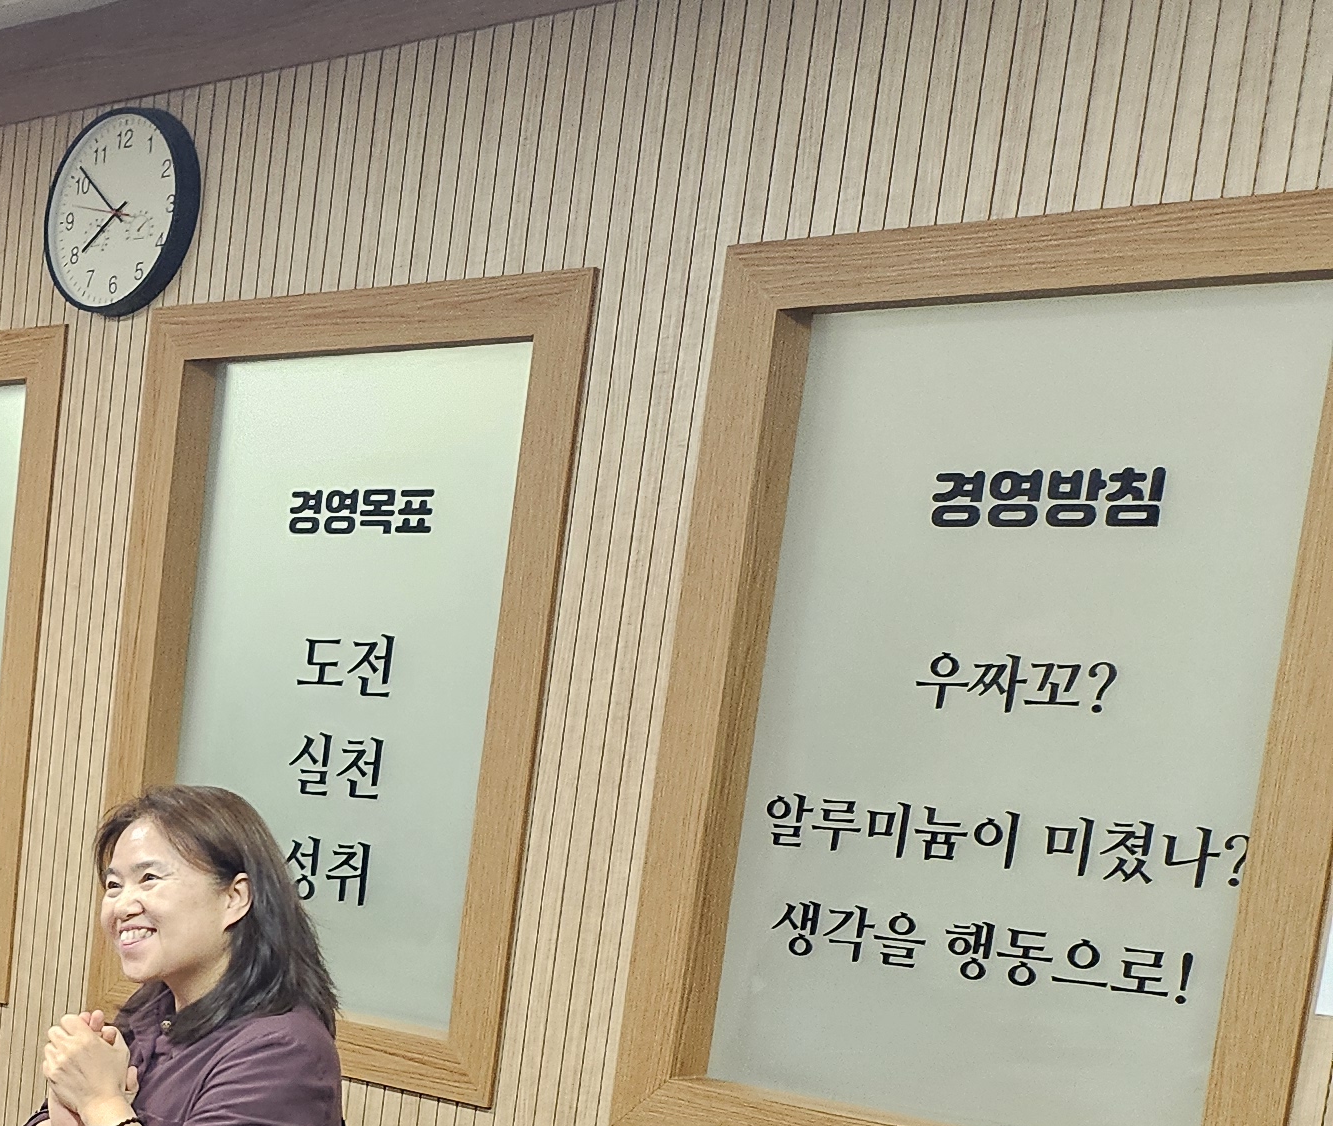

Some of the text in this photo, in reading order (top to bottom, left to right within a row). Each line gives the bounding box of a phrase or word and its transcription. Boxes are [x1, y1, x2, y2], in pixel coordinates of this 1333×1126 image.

[117, 128, 133, 149] 12
[146, 135, 154, 153] 1
[93, 146, 107, 165] 11
[160, 158, 172, 179] 2
[74, 177, 91, 195] 10
[165, 194, 176, 214] 3
[65, 211, 75, 231] 9
[155, 231, 166, 248] 4
[69, 246, 79, 265] 8
[86, 269, 95, 288] 7
[133, 261, 144, 281] 5
[108, 275, 118, 294] 6
[931, 466, 1167, 528] 경영방침
[288, 488, 435, 535] 경영목표
[296, 633, 395, 698] 도전
[915, 651, 1118, 714] 우짜꼬?
[288, 731, 384, 800] 실천
[766, 792, 1251, 889] 알루미늄이 미쳤나?
[286, 835, 372, 907] 성취
[771, 900, 1194, 1005] 생각을 행동으로!
